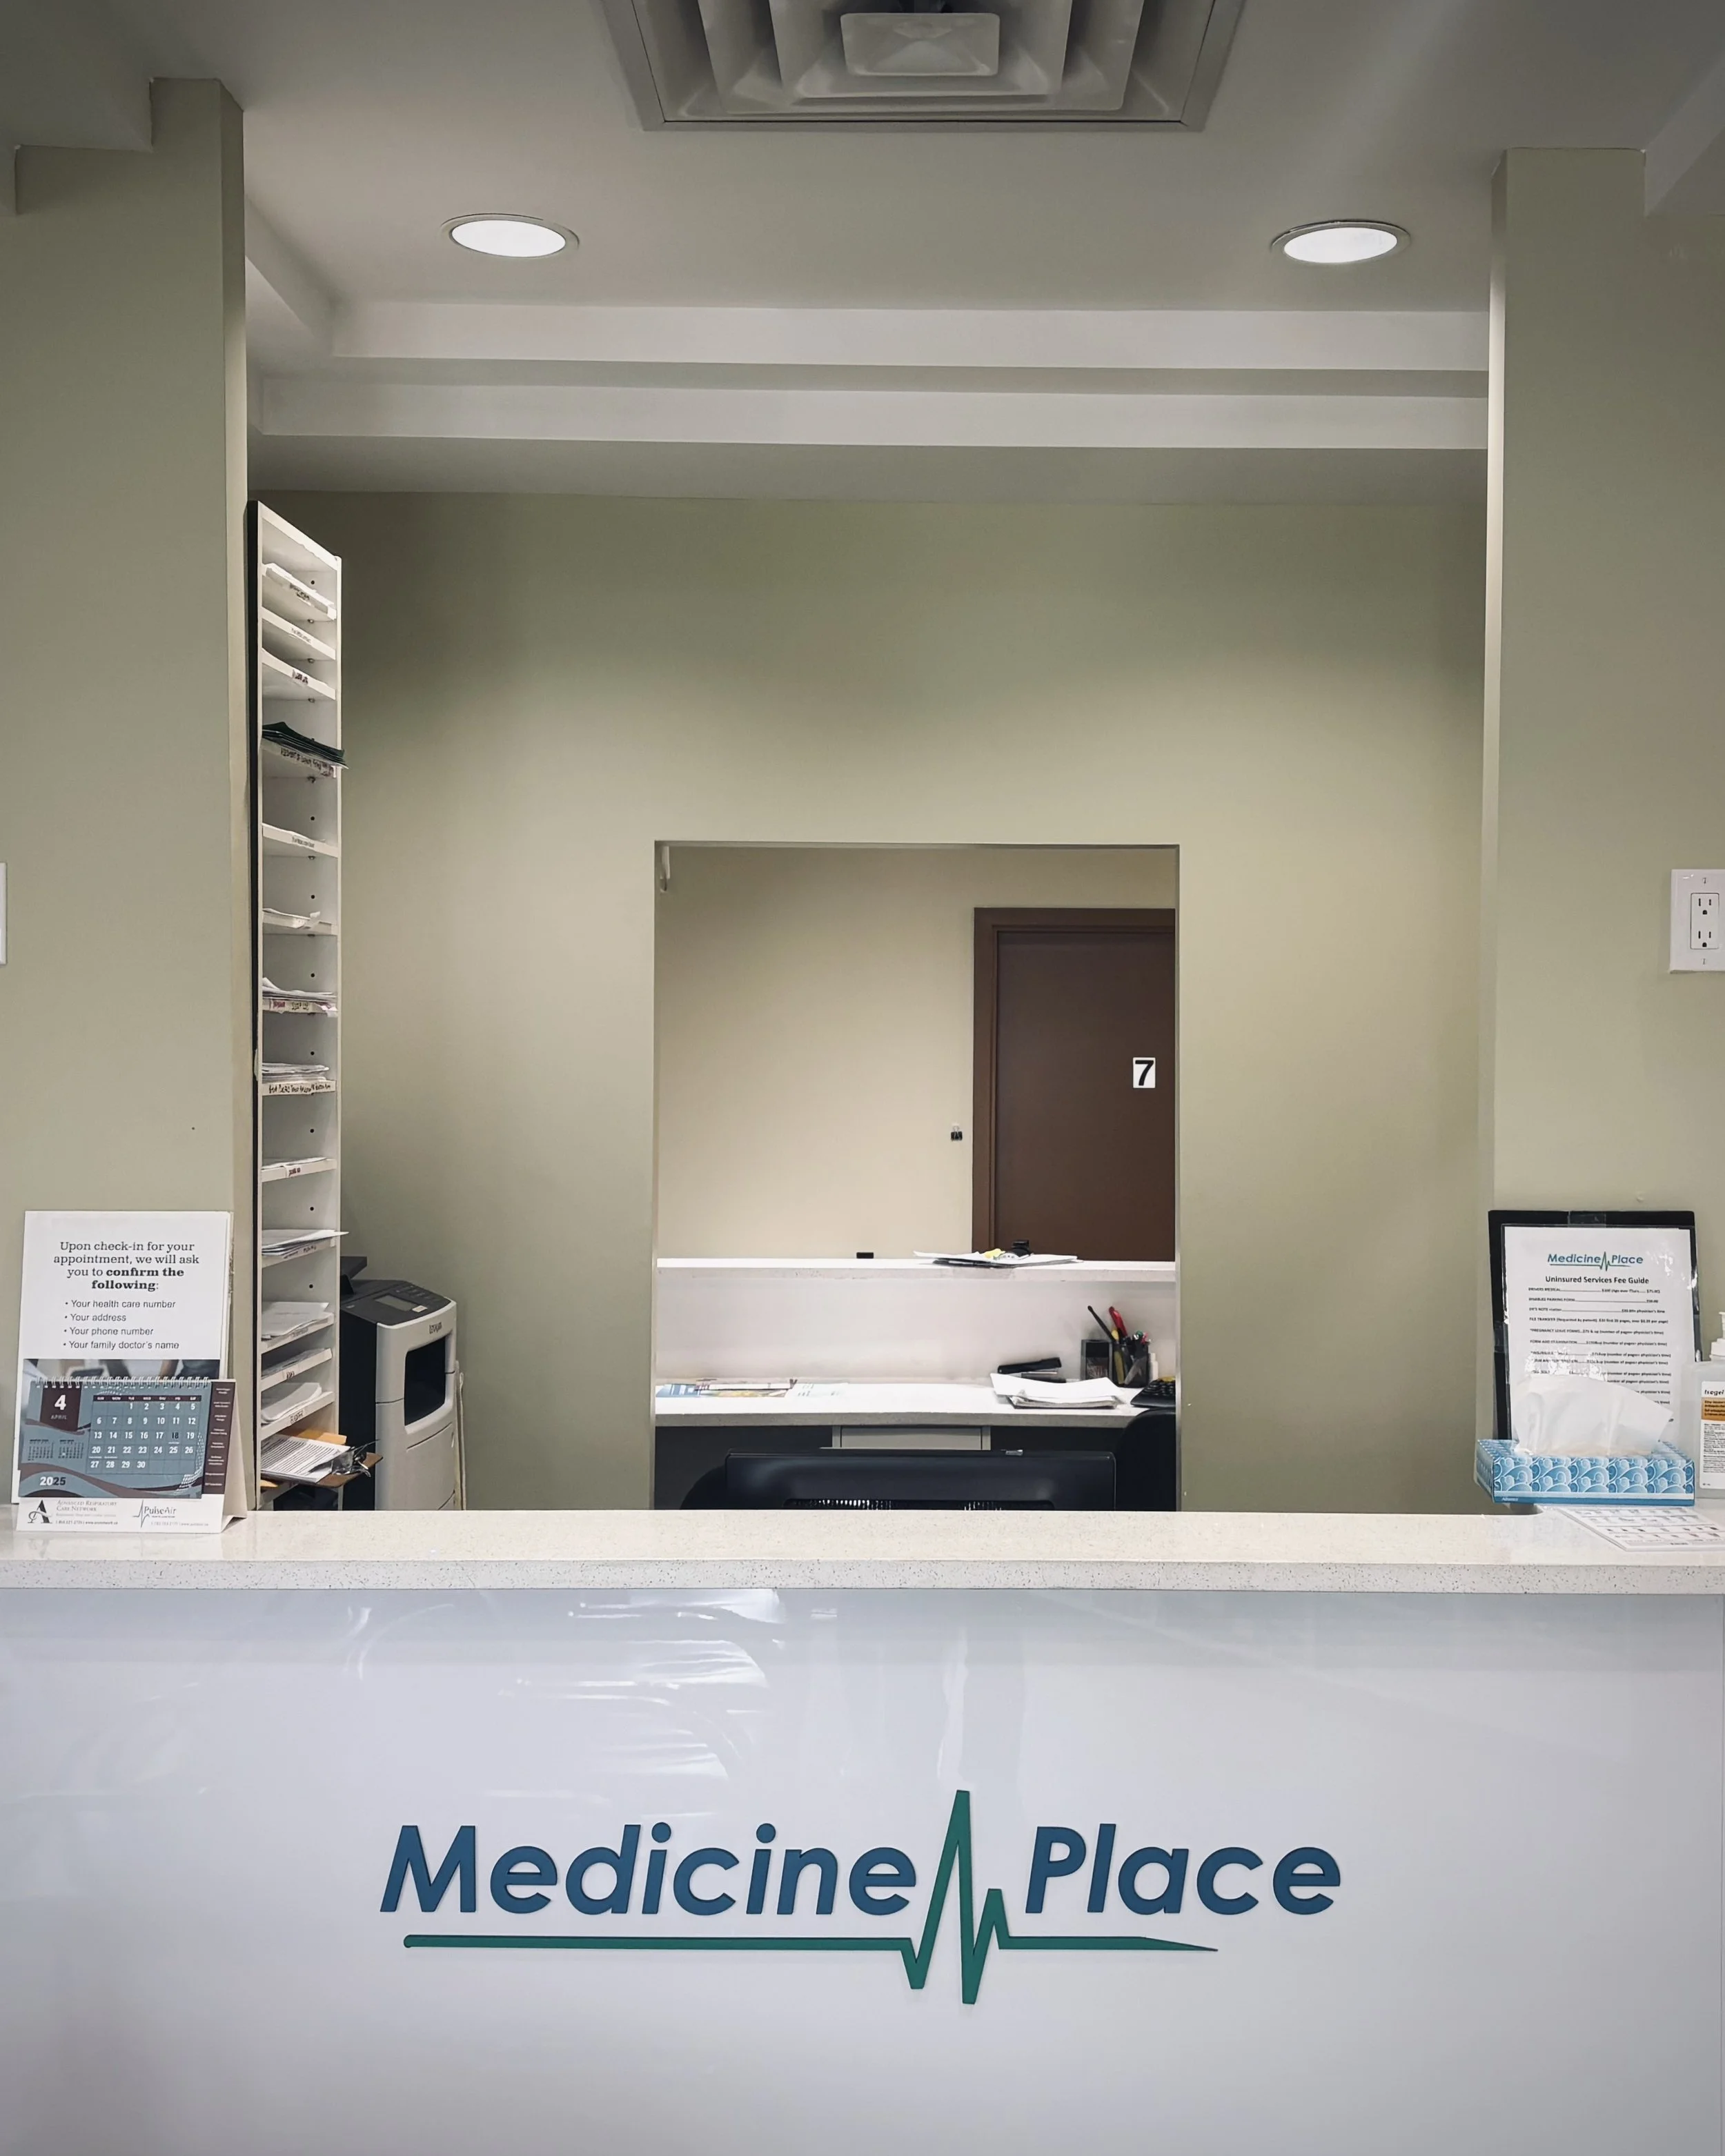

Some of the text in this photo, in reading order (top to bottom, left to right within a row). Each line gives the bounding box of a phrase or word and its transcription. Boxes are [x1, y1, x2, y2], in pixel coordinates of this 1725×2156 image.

[1135, 1060, 1154, 1086] 7
[61, 1241, 195, 1253] Upon check-in for your
[54, 1254, 132, 1265] appointment,
[155, 1254, 176, 1264] will
[179, 1254, 199, 1264] ask
[1547, 1254, 1644, 1264] Medicine Place
[67, 1267, 184, 1278] you to confirm the
[91, 1280, 159, 1292] following:
[70, 1327, 89, 1335] Your
[91, 1327, 118, 1336] phone
[69, 1341, 88, 1349] Your
[90, 1341, 116, 1350] family
[118, 1341, 152, 1349] doctor's
[55, 1394, 67, 1411] 4
[40, 1476, 66, 1485] 2025
[379, 1822, 1341, 1915] Medicine Place
